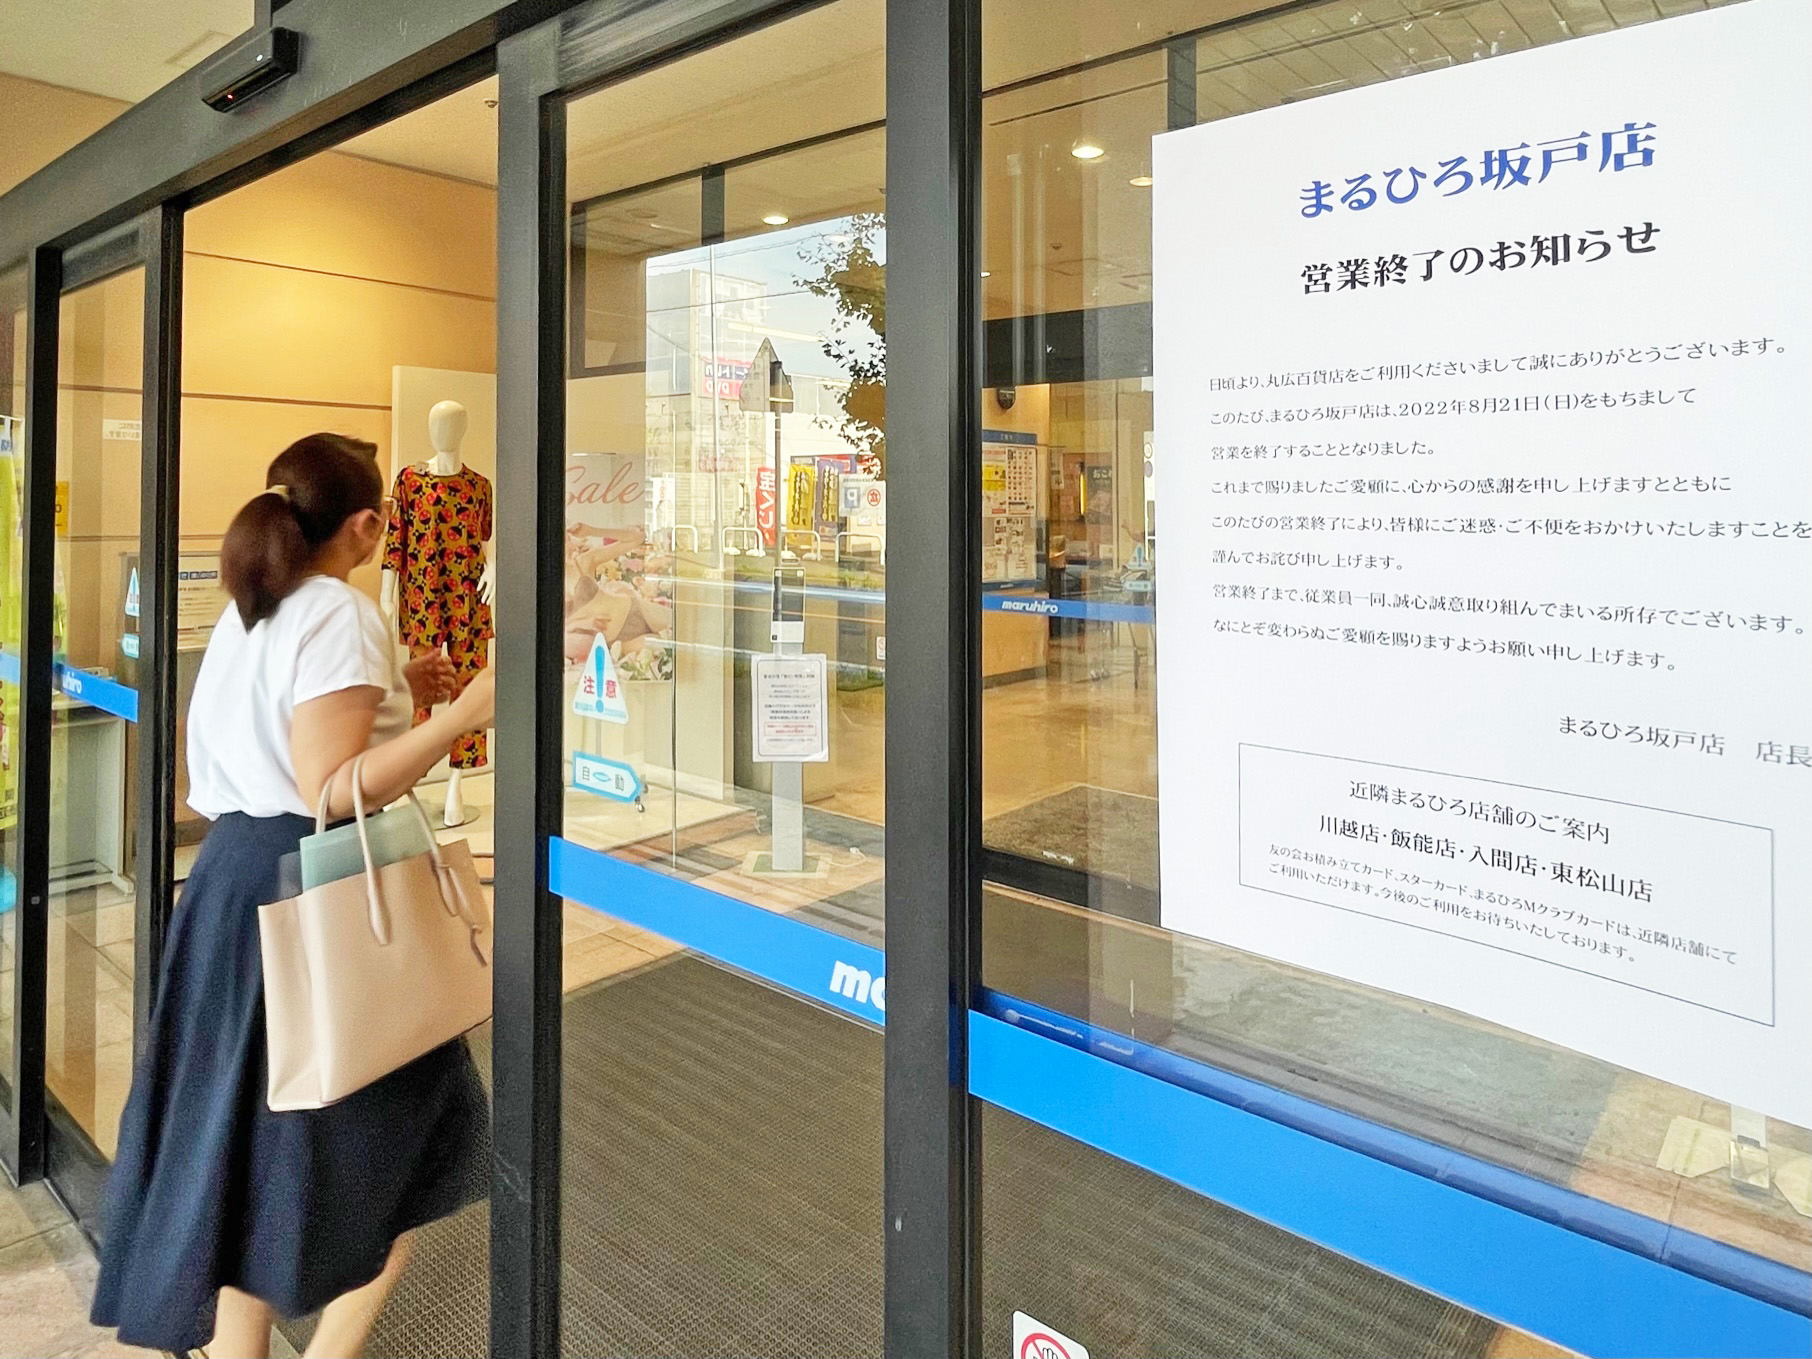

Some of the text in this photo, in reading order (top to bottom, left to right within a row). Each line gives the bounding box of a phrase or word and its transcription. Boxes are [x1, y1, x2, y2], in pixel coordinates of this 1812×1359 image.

[1300, 121, 1657, 219] まるひろ坂戸店
[1301, 221, 1661, 295] 営業終了のお知らせ
[1209, 338, 1785, 391] 日頃より、丸広百貨店をご利用くださいまして誠にありがとうございます。
[1211, 440, 1434, 461] 営業を終了することとなりました。
[1211, 475, 1732, 495] これまで賜りましたご愛顧に、心からの感謝を申し上げますとともに
[1212, 549, 1403, 571] 謹んでお詫び申し上げます。
[1001, 600, 1059, 614] maruhiro
[1212, 583, 1804, 635] 営業終了まで、従業員一同、誠心誠意取り組んでまいる所存でございます。
[1213, 618, 1675, 671] なにとぞ変わらぬご愛顧を賜りますようお願い申し上げます。
[1559, 715, 1812, 768] まるひろ坂戸店 店長
[1349, 780, 1610, 845] 近隣まるひろ店舗のご案内
[1319, 814, 1653, 904] 川越店・飯能店・入間店・東松山店
[1269, 862, 1635, 963] ご利用いただけます。今後のご利用をお待ちいたしております。
